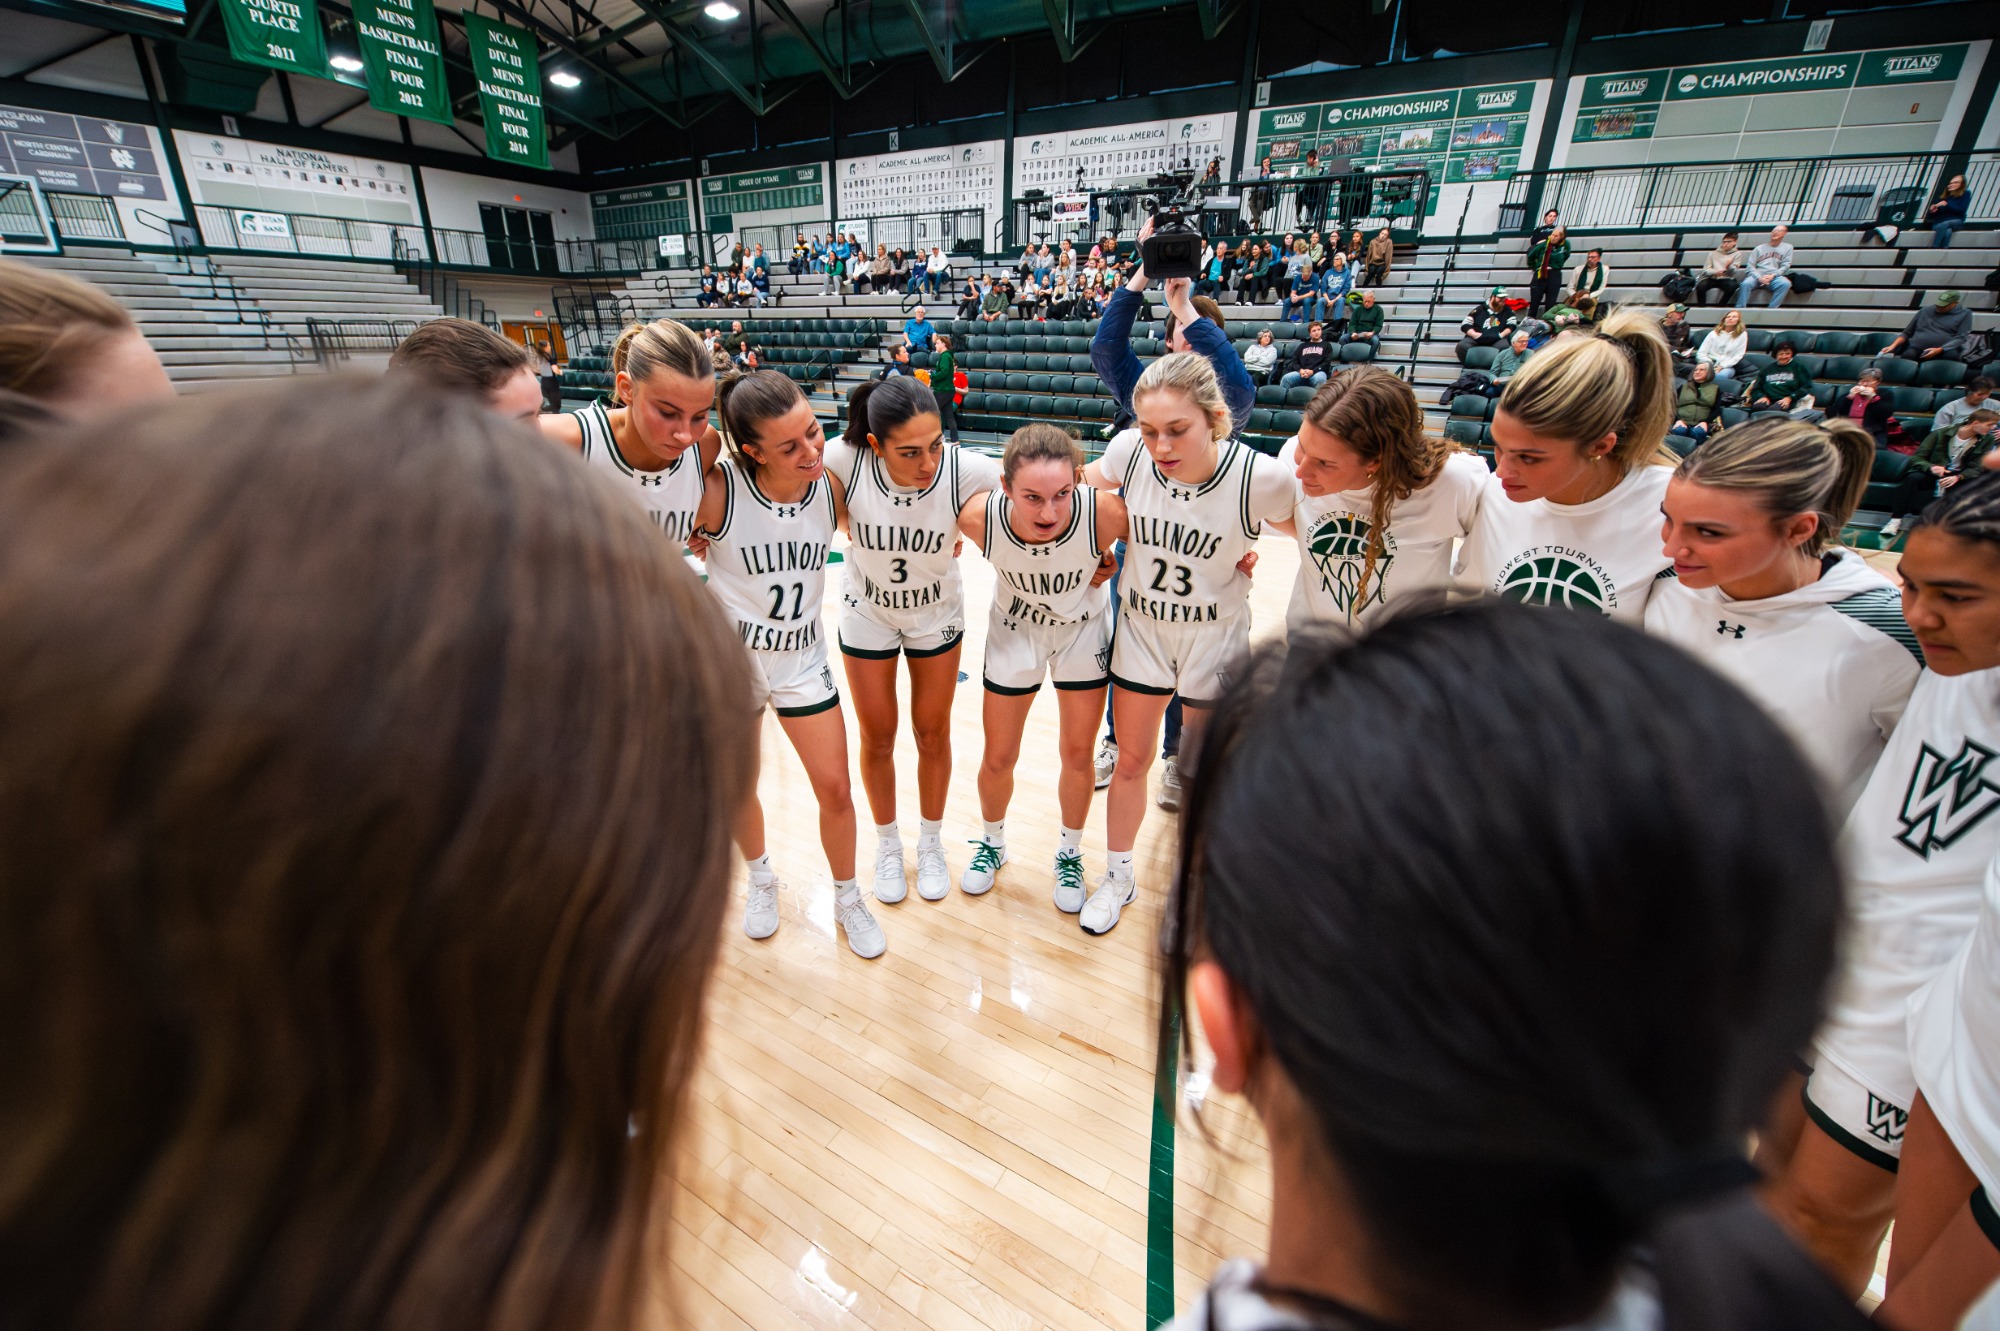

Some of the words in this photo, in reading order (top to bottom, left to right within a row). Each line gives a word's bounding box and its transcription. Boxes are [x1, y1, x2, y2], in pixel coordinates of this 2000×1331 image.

[248, 8, 300, 33] PLACE
[376, 7, 416, 30] MEN'S
[359, 21, 439, 56] BASKETBALL
[488, 29, 519, 50] NCAA
[1807, 24, 1831, 46] M
[267, 43, 296, 62] 2011
[385, 49, 424, 70] FINAL
[488, 48, 509, 64] DIV.
[510, 54, 523, 68] III
[1888, 54, 1940, 71] TITANS
[390, 69, 426, 90] FOUR
[492, 67, 524, 86] MEN'S
[1700, 64, 1847, 89] CHAMPIONSHIPS
[479, 80, 542, 107] BASKETBALL
[1258, 86, 1267, 102] L
[1605, 80, 1647, 94] TITANS
[398, 91, 424, 107] 2012
[1478, 91, 1516, 104] TITANS
[497, 103, 529, 121] FINAL
[1274, 113, 1306, 125] TITANS
[1343, 99, 1450, 121] CHAMPIONSHIPS
[502, 122, 530, 138] FOUR
[1070, 135, 1108, 147] ACADEMIC
[1111, 129, 1165, 142] ALL-AMERICA
[13, 139, 44, 149] NORTH
[45, 143, 81, 154] CENTRAL
[509, 141, 529, 155] 2014
[891, 135, 897, 148] K
[28, 149, 73, 160] CARDINALS
[260, 154, 289, 166] HALL
[293, 159, 306, 168] OF
[311, 161, 349, 174] FAMERS
[276, 148, 331, 164] NATIONAL
[879, 159, 908, 169] ACADEMIC
[36, 168, 78, 179] WHEATON
[40, 176, 79, 187] THUNDER
[738, 178, 754, 187] ORDER
[763, 174, 779, 183] TITANS
[797, 168, 814, 178] TITANS
[260, 215, 285, 223] TITAN
[263, 224, 286, 233] BAND
[650, 510, 694, 542] NOIS
[1306, 511, 1337, 543] MIDWEST
[857, 522, 945, 554] ILLINOIS
[1133, 515, 1222, 560] ILLINOIS
[740, 541, 827, 575] ILLINOIS
[889, 558, 908, 584] 3
[1150, 558, 1193, 597] 23
[1493, 547, 1539, 592] MIDWEST
[1544, 545, 1618, 609] TOURNAMENT
[864, 575, 942, 609] WESLEYAN
[1000, 568, 1083, 596] ILLINOIS
[768, 582, 805, 621] 22
[1129, 587, 1218, 622] WESLEYAN
[738, 619, 817, 651] WESLEYAN
